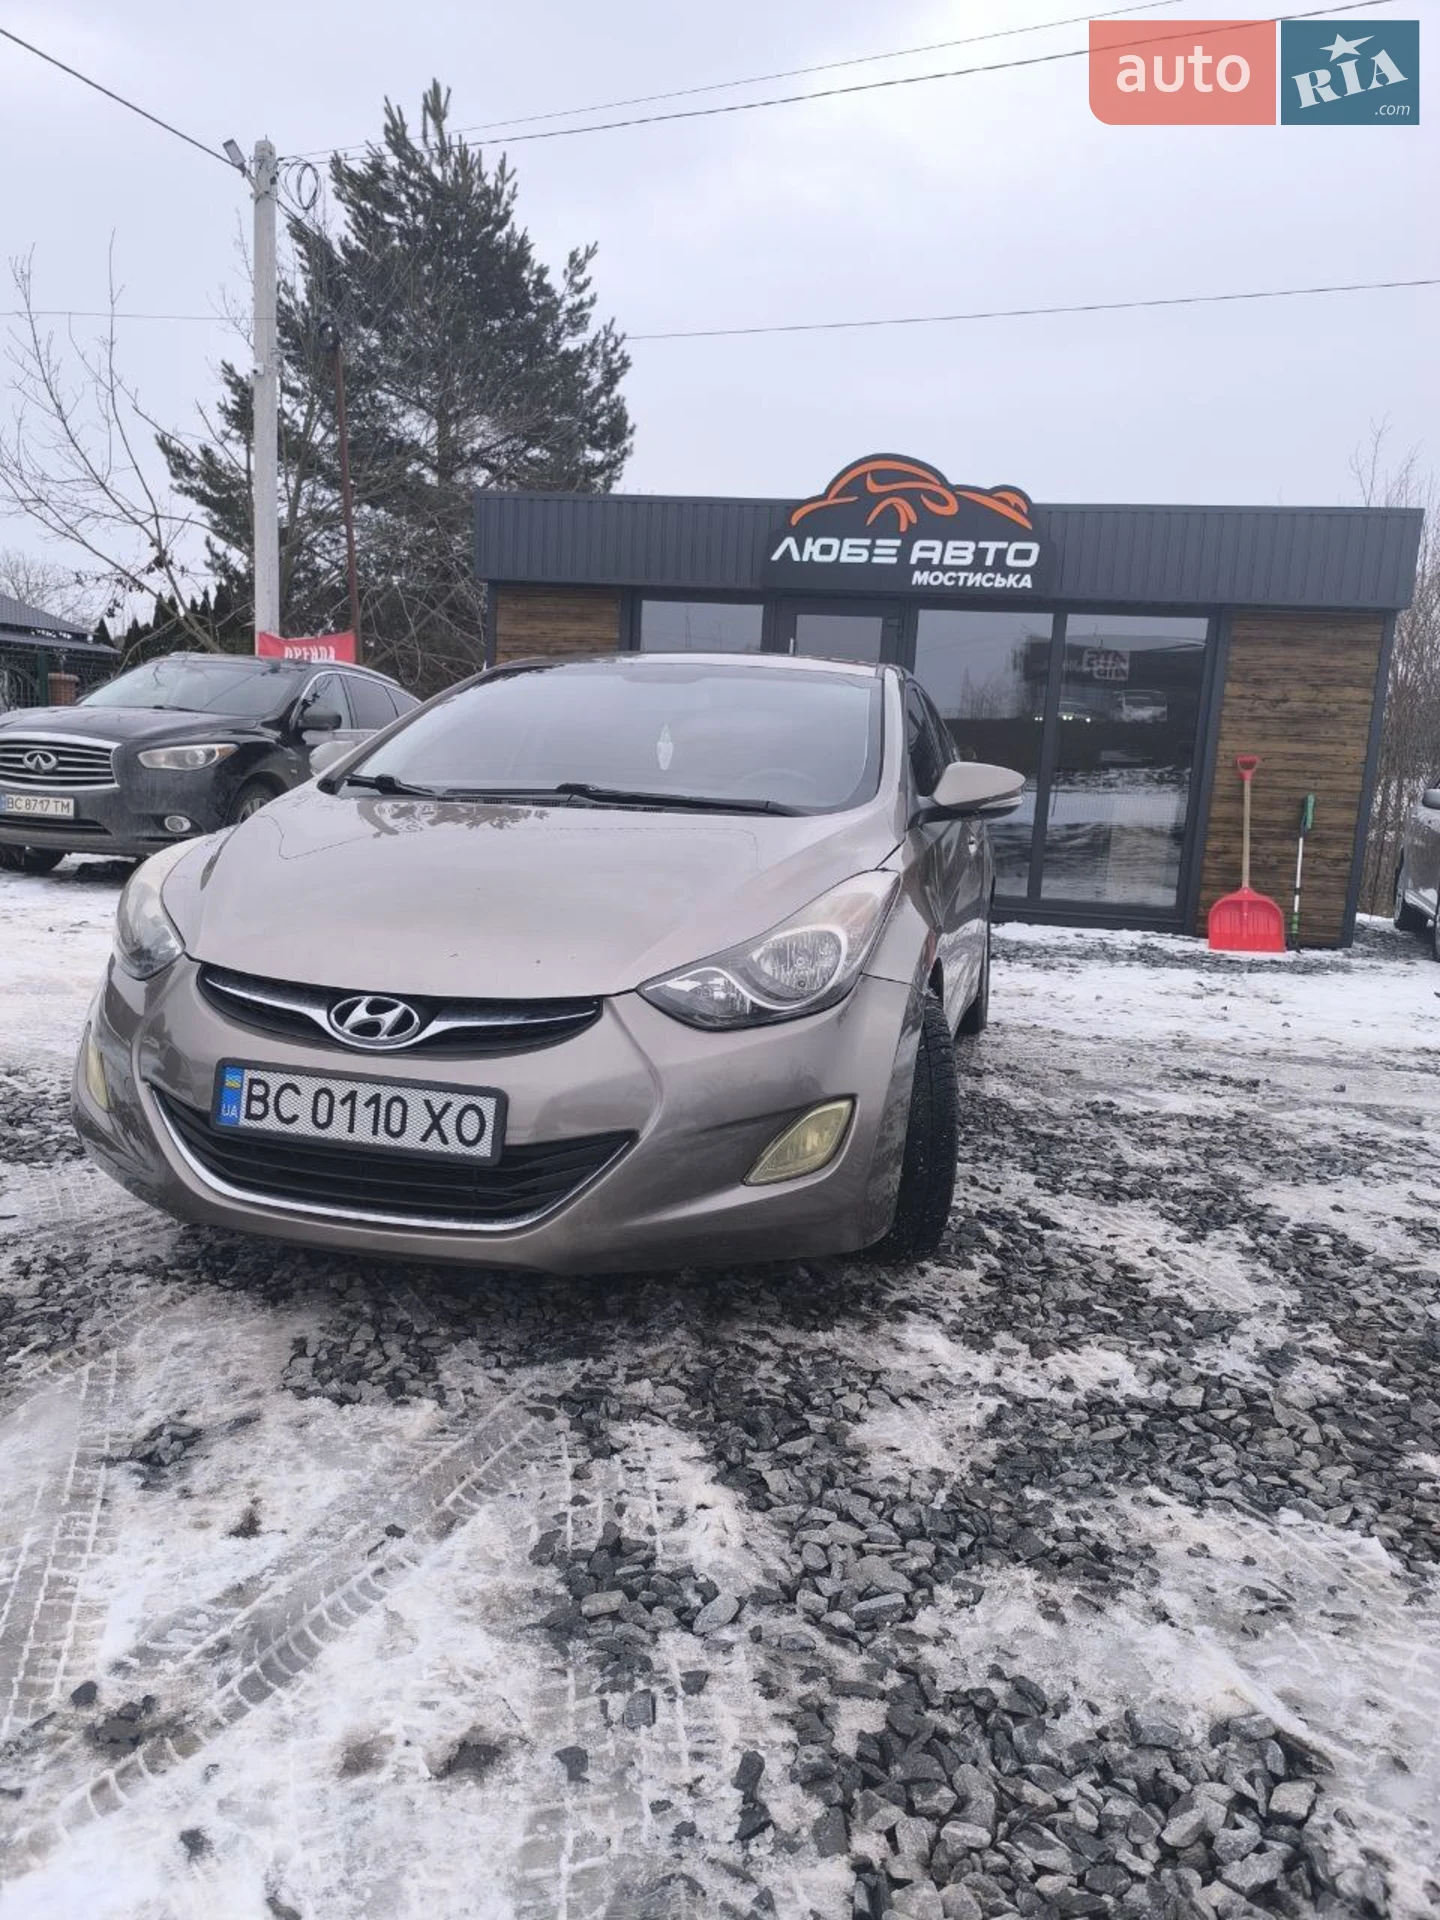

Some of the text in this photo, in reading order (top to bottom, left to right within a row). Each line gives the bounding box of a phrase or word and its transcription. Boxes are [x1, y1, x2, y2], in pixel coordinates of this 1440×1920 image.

[770, 536, 1040, 568] ЛЮБЕ АВТО
[911, 570, 1033, 589] МОСТИСЬКА
[6, 797, 70, 813] BC 8717 TM
[221, 1107, 239, 1119] UA
[244, 1078, 487, 1147] BC 0110 XO
